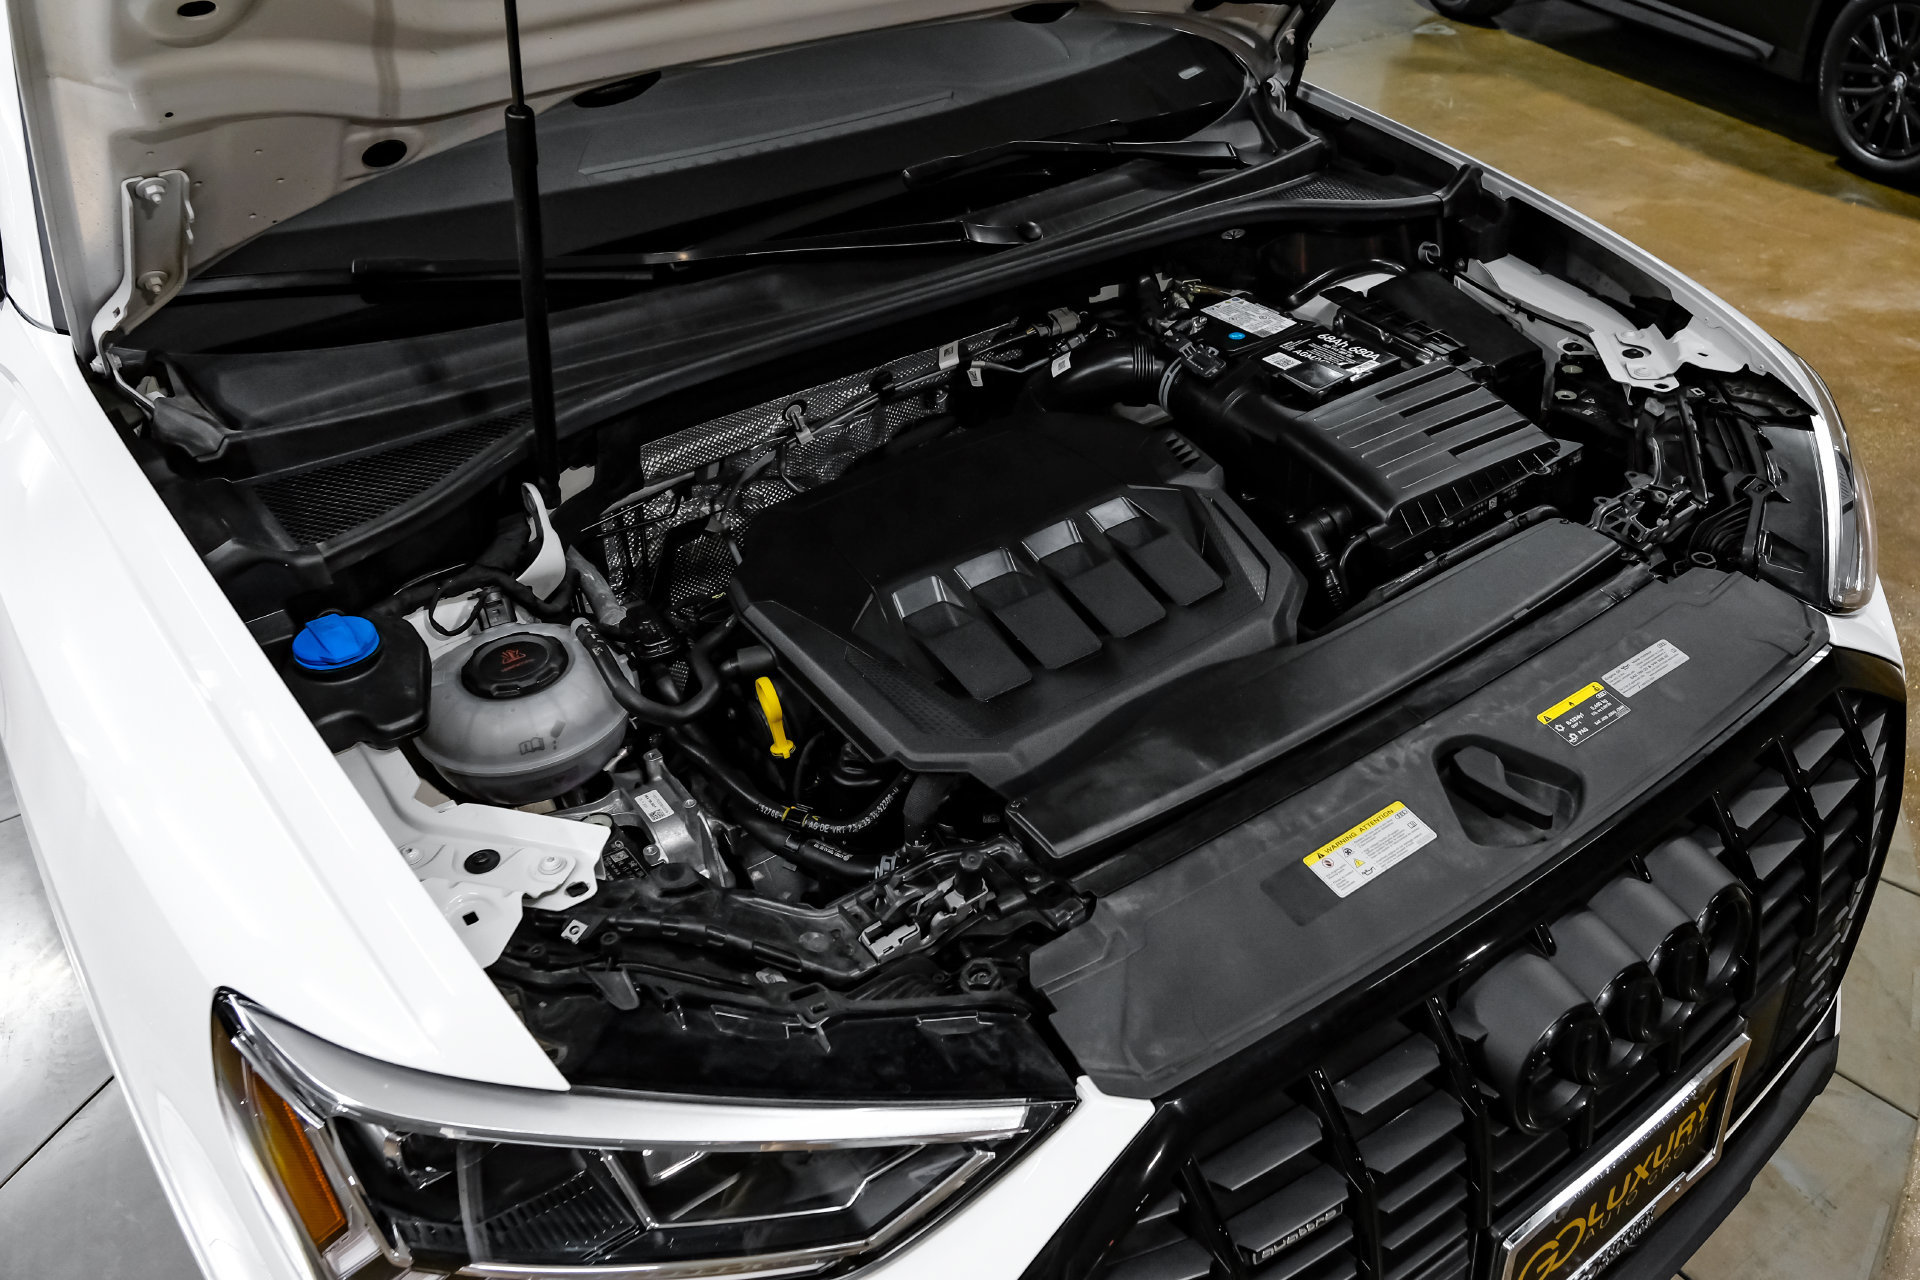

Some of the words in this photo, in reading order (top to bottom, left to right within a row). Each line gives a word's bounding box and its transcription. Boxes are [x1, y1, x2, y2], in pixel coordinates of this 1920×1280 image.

[1317, 333, 1349, 348] 68Ah
[1348, 346, 1380, 361] 680A
[1324, 831, 1358, 854] WARNING
[1359, 808, 1394, 833] ATTENTION
[1583, 1188, 1639, 1245] AUTO
[1647, 1115, 1710, 1186] GROUP
[1587, 1087, 1718, 1227] LUXURY
[1261, 1209, 1337, 1259] quattro
